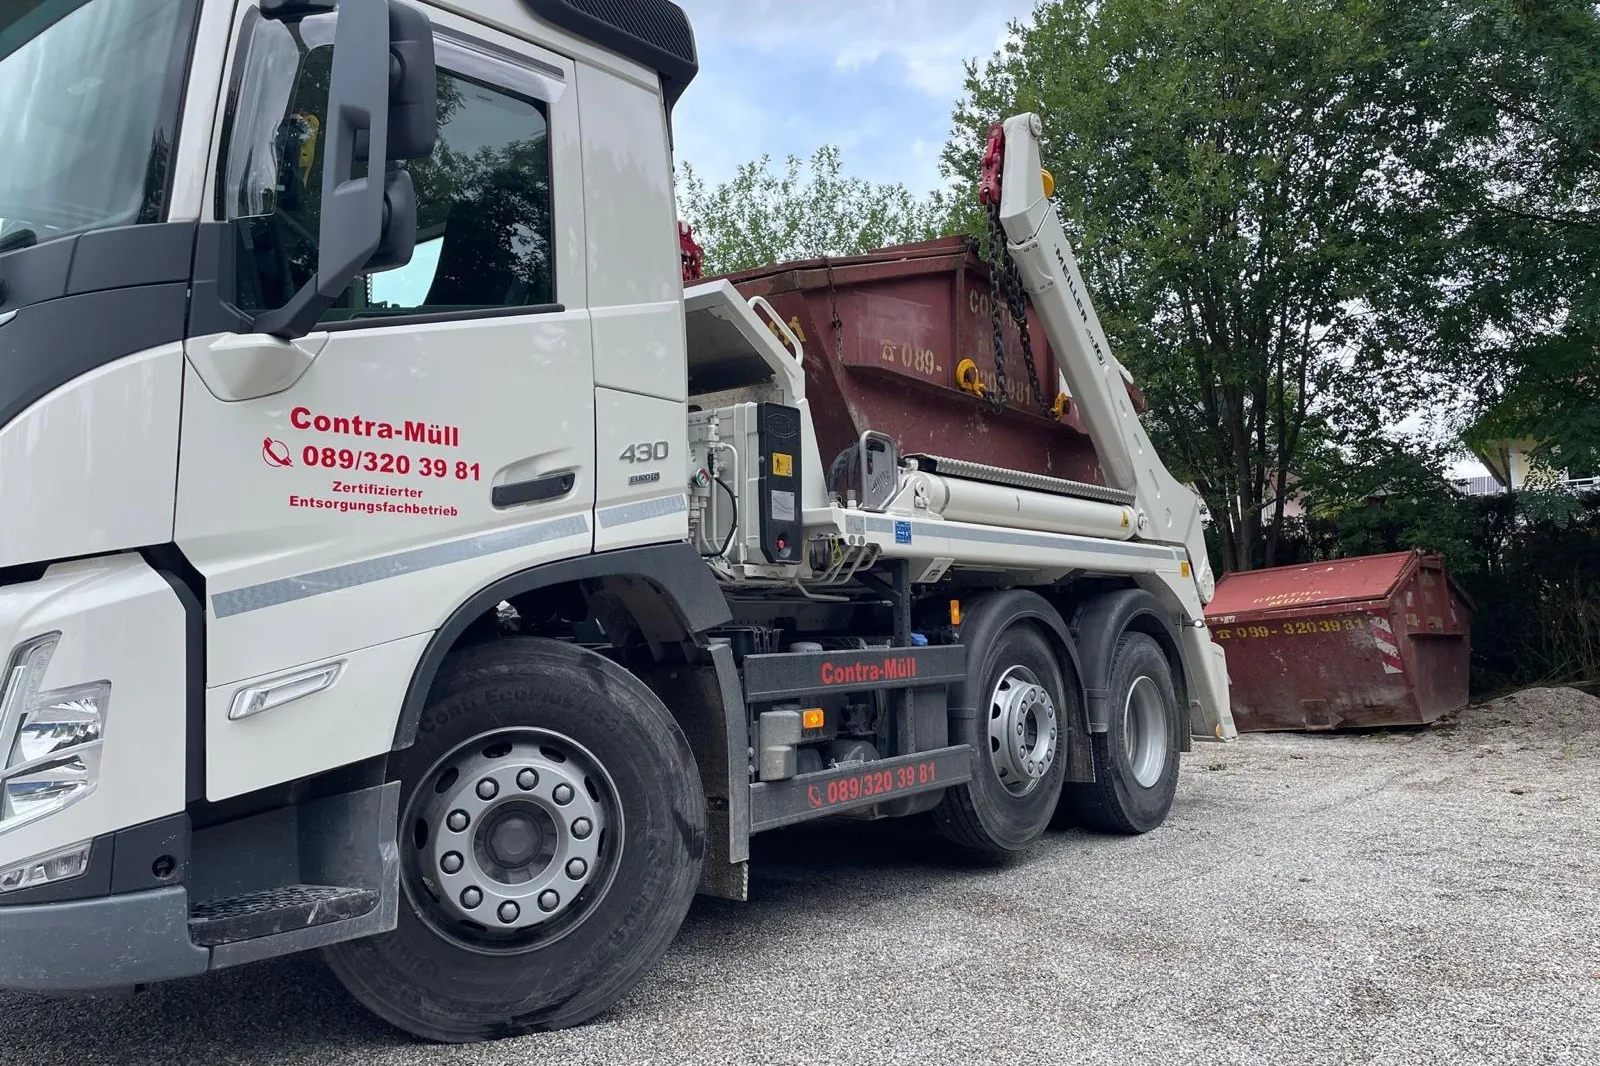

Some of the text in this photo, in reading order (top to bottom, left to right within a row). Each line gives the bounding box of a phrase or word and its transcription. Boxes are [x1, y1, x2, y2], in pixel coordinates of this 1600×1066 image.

[1055, 247, 1088, 324] MEILLER
[290, 406, 459, 447] Contra-Müll
[302, 445, 480, 481] 089/320 39 81
[619, 440, 669, 464] 430
[289, 495, 458, 517] Entsorgungsfachbetrieb
[332, 481, 423, 499] Zertifizierter
[821, 656, 916, 685] Contra-Müll
[827, 762, 936, 804] 089/320 39 81
